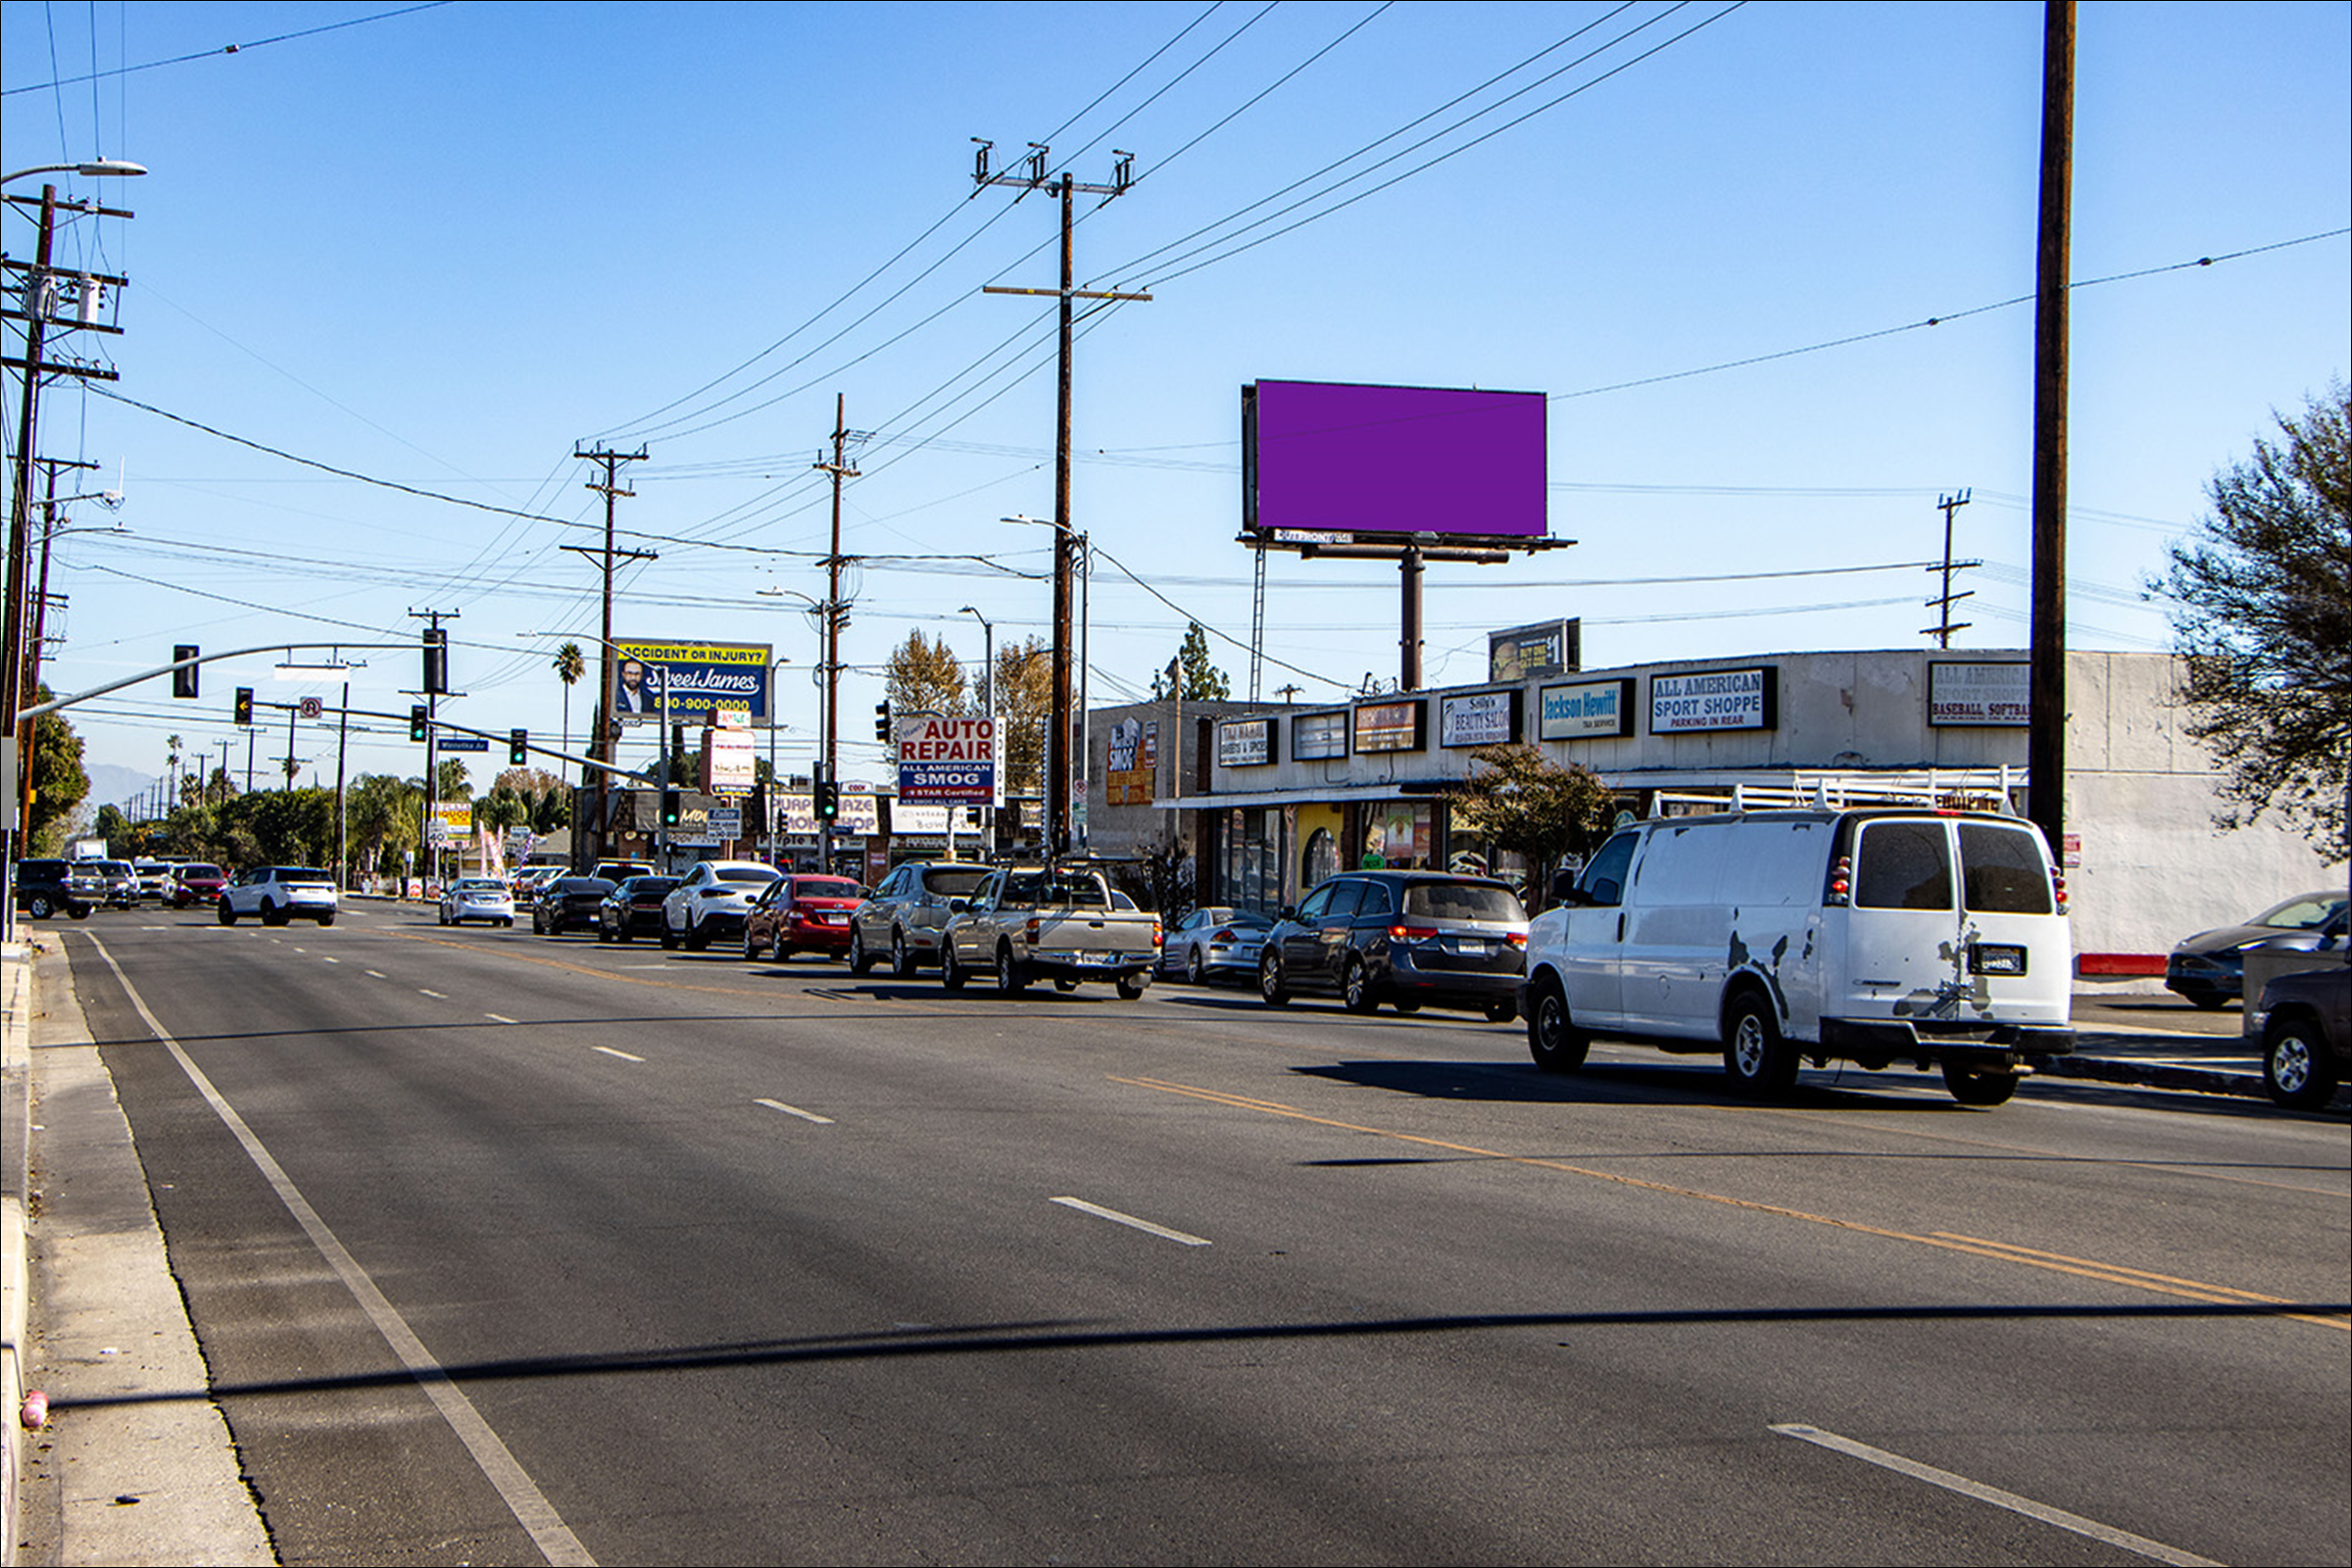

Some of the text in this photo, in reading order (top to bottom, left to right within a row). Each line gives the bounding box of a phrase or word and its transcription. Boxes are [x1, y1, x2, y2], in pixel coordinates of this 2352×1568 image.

[622, 647, 761, 662] ACCIDENT OR INJURY?
[699, 667, 757, 690] James
[1654, 673, 1761, 698] ALL AMERICAN
[654, 696, 750, 711] 80-900-0000
[1544, 689, 1617, 720] Jackson Hewitt
[1654, 695, 1760, 717] SPORT SHOPPE
[924, 719, 994, 740] AUTO
[1455, 711, 1484, 731] BEAUTY
[1671, 714, 1743, 728] PARKING IN REAR
[901, 740, 993, 760] REPAIR
[913, 772, 980, 786] SMOG
[428, 833, 445, 842] 40
